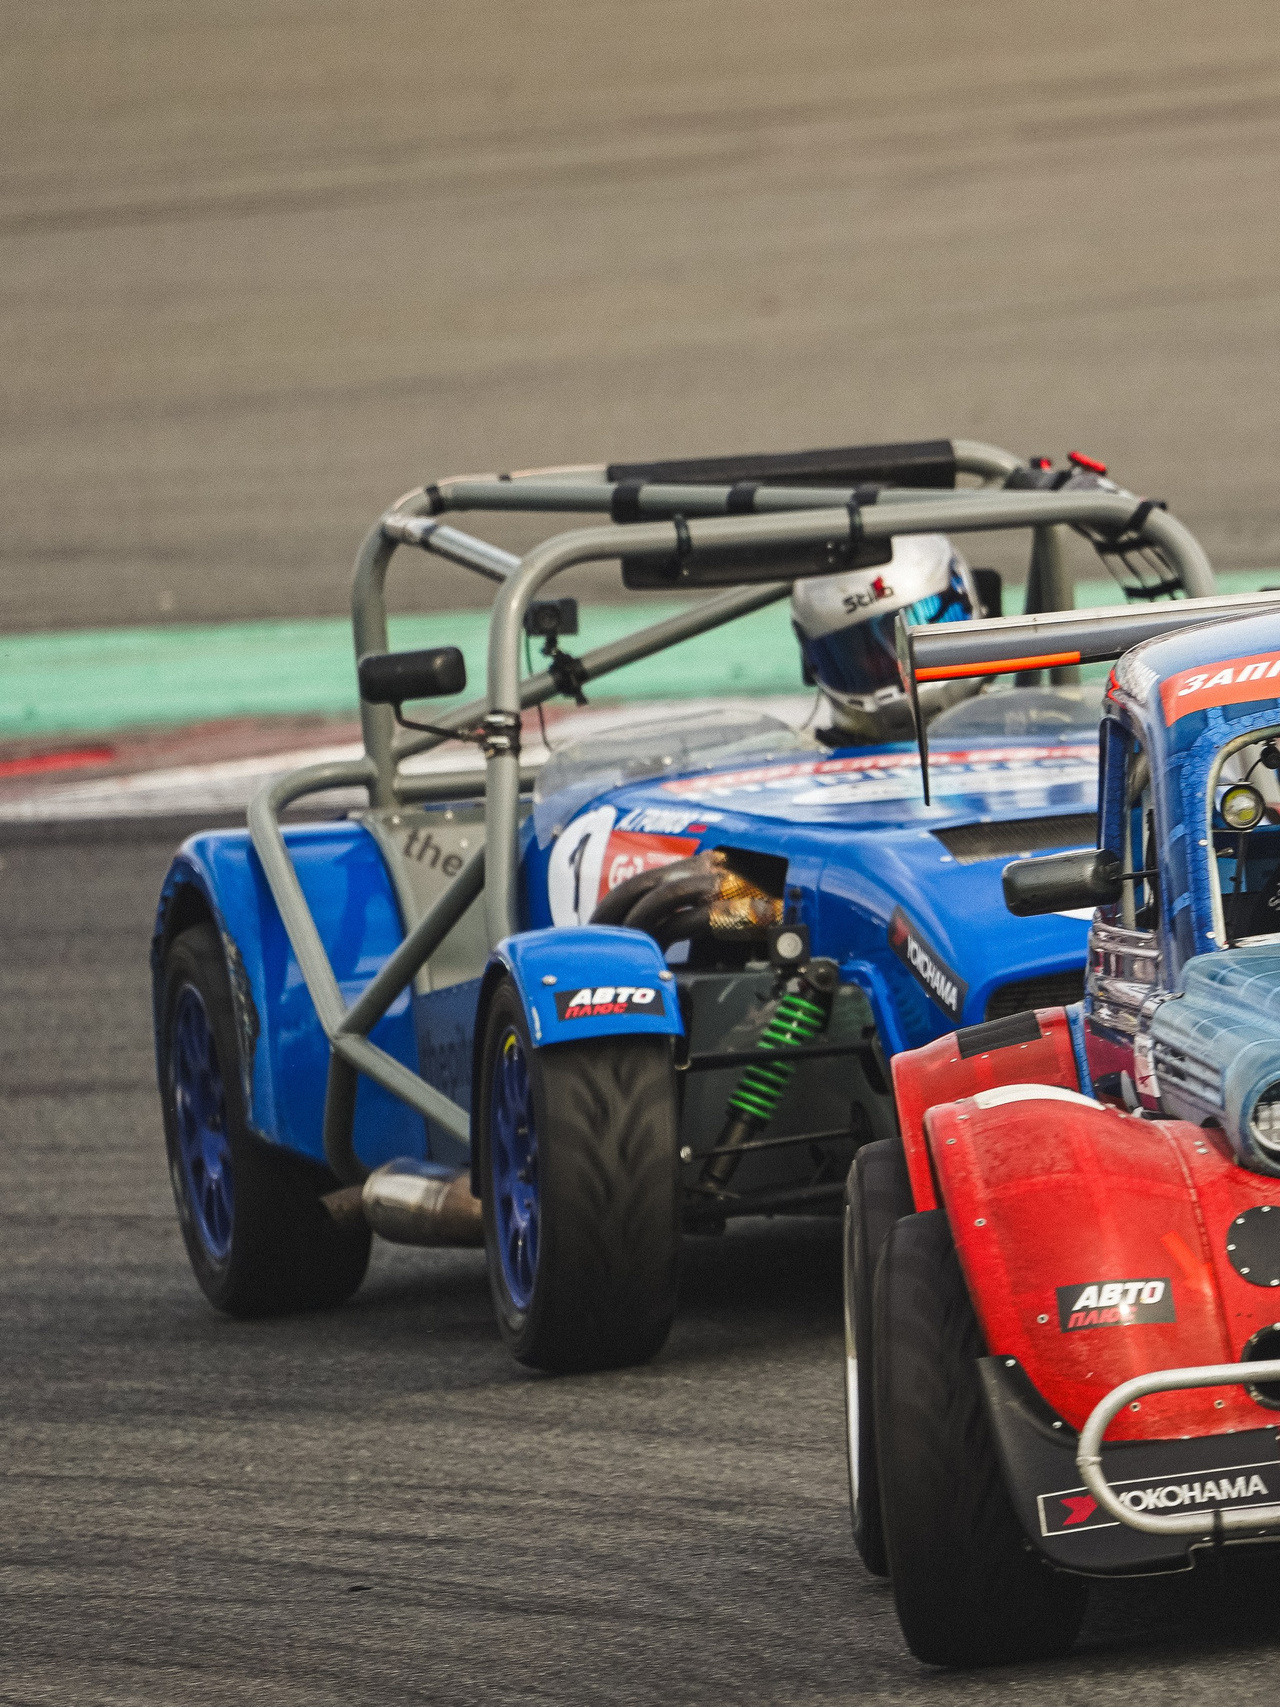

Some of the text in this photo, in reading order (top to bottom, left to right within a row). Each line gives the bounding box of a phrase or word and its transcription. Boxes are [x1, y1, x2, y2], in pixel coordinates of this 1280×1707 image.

[403, 828, 463, 877] the
[568, 832, 592, 913] 1
[564, 1002, 628, 1019] ПЛЮС
[568, 986, 657, 1008] АВТО
[1072, 1280, 1166, 1311] АВТО
